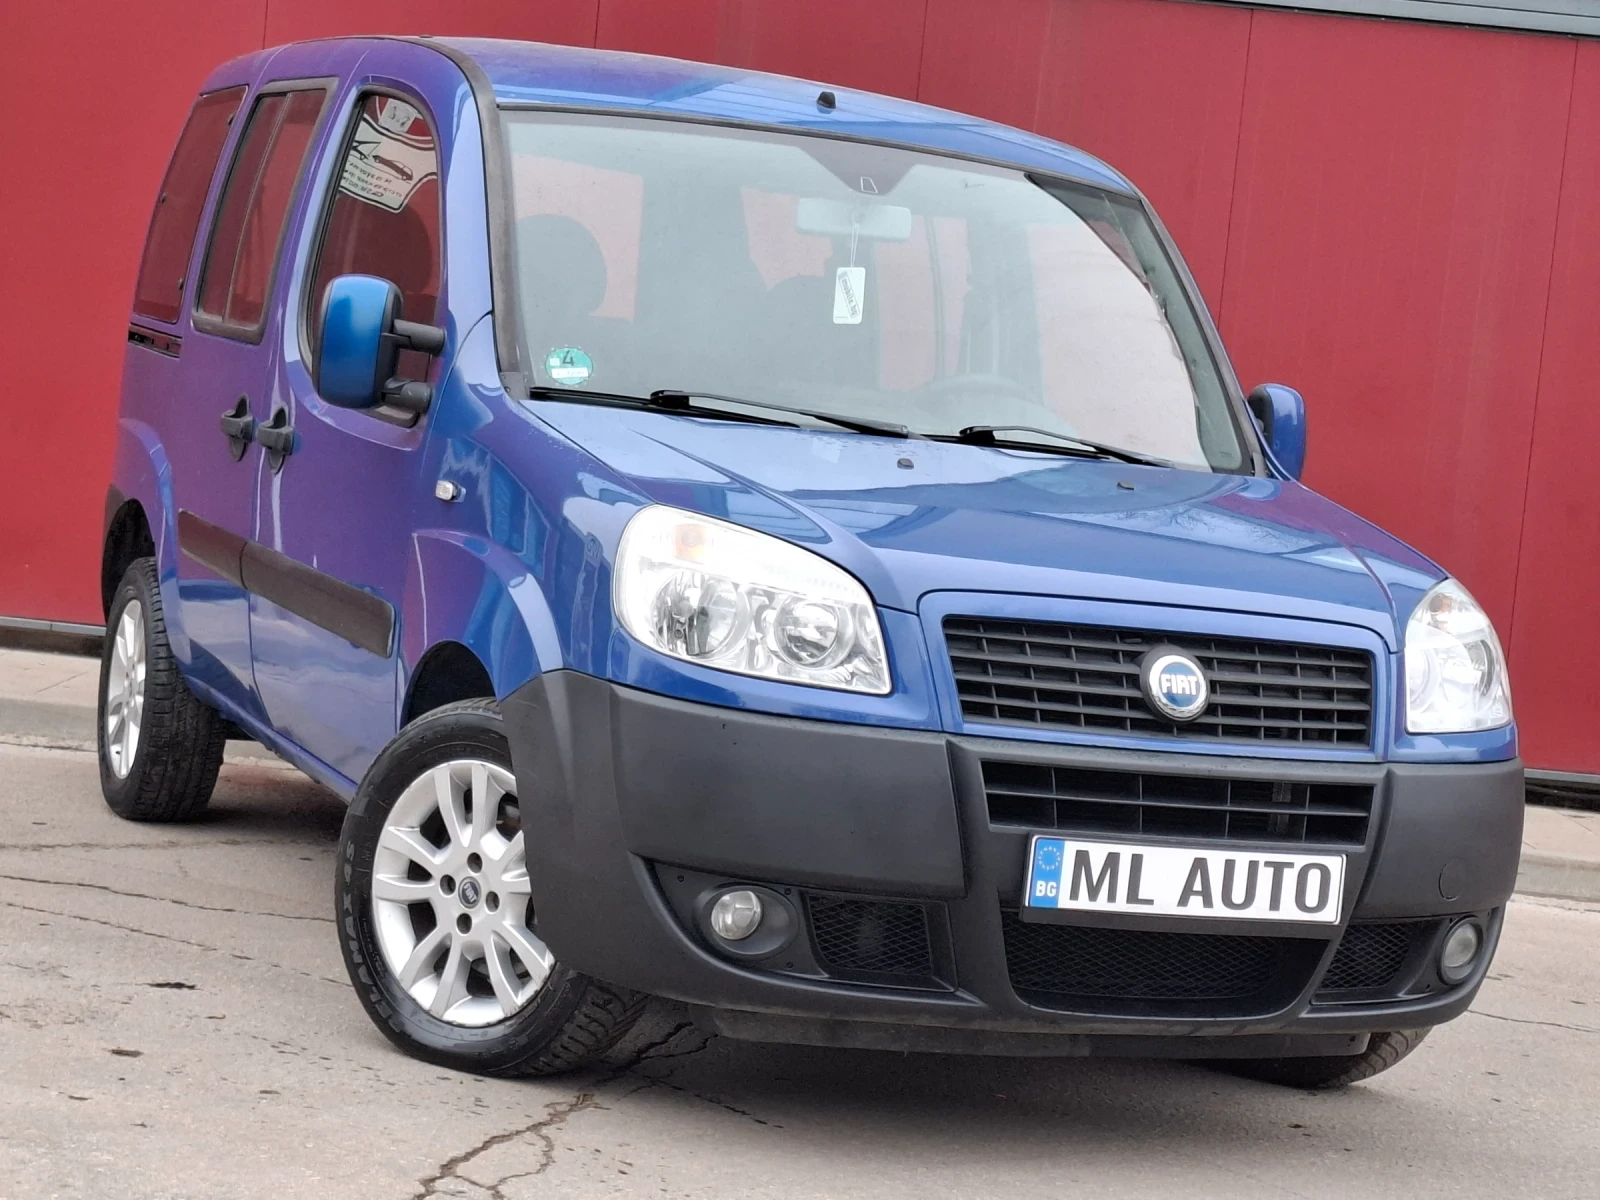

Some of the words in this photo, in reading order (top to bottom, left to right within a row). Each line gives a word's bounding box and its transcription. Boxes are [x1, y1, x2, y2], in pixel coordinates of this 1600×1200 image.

[562, 350, 575, 367] 4
[1161, 673, 1198, 696] FIAT
[1035, 880, 1058, 897] BG
[1069, 849, 1155, 906] ML
[1176, 856, 1332, 914] AUTO
[463, 882, 478, 903] FIAT
